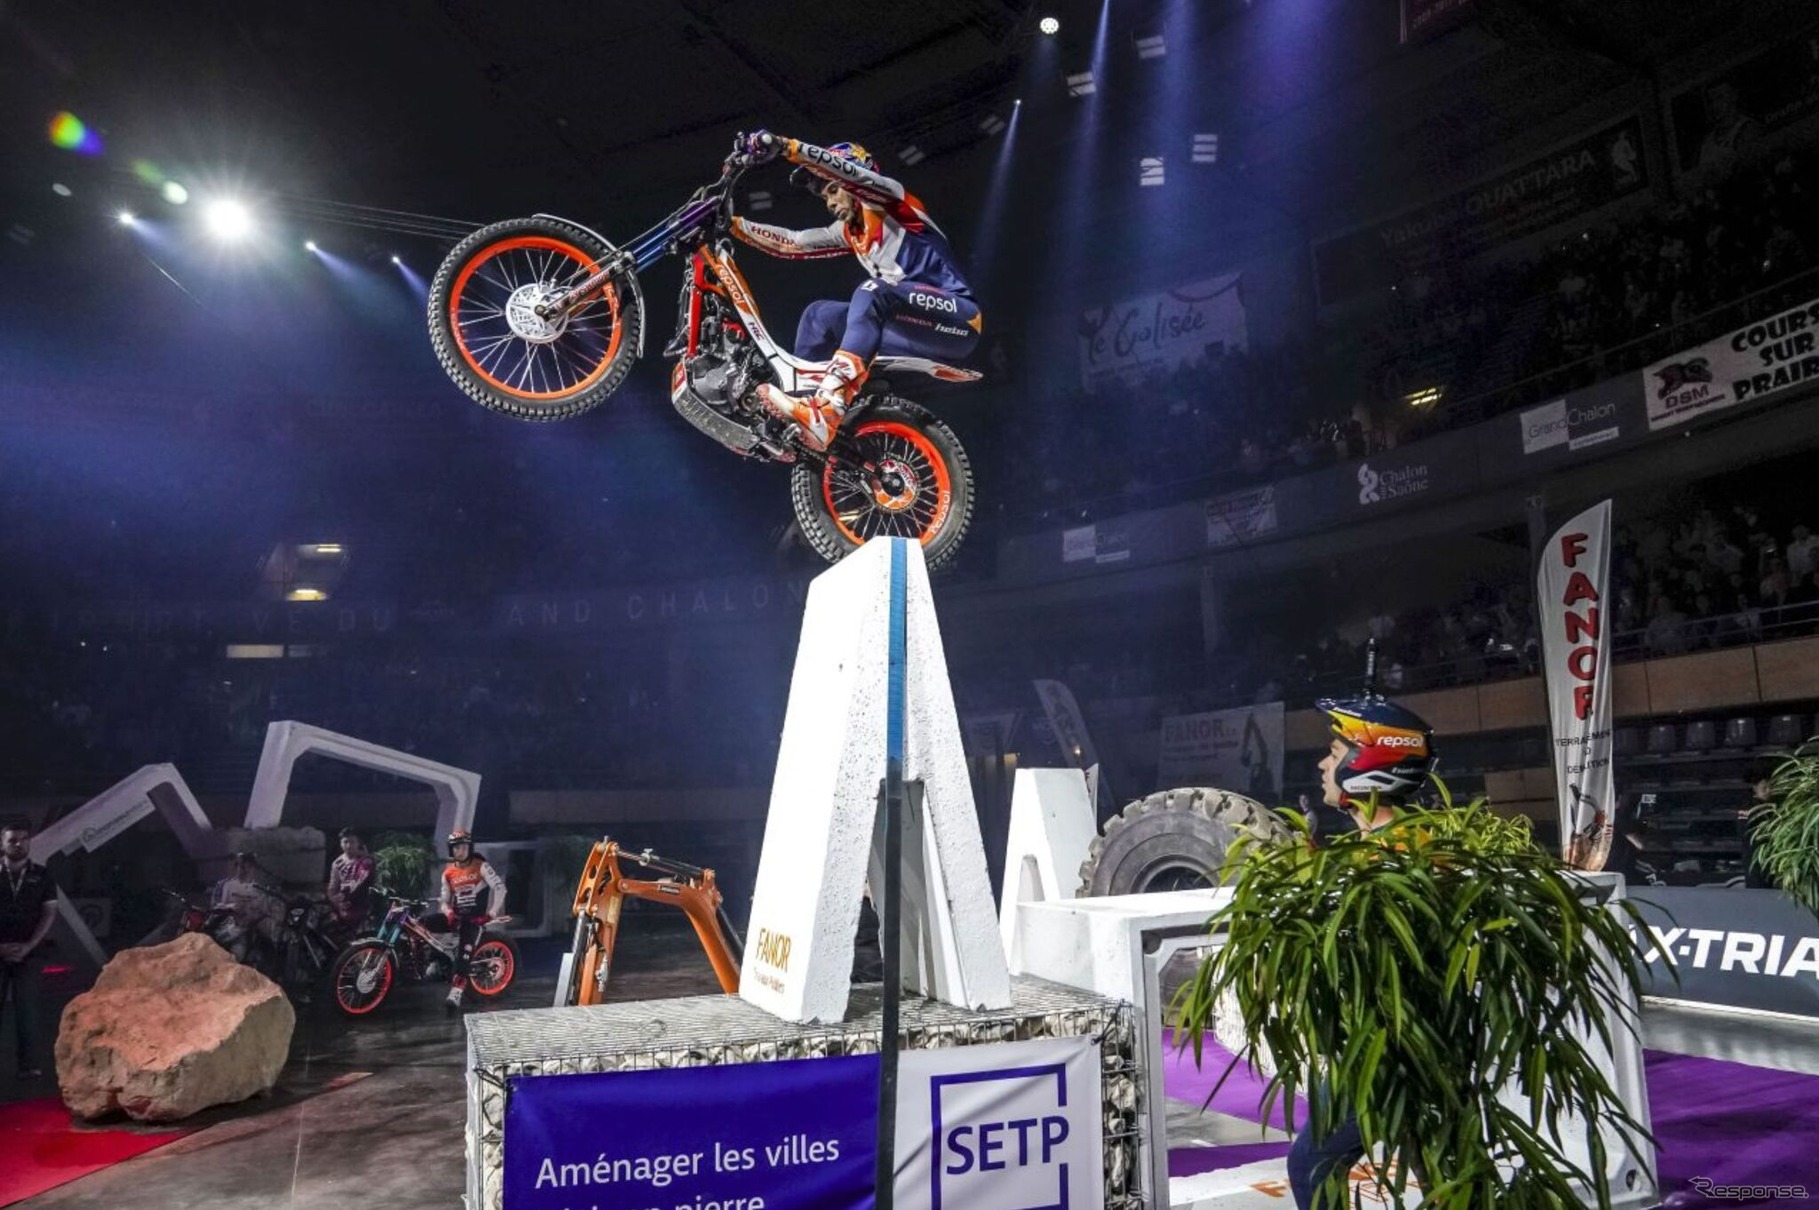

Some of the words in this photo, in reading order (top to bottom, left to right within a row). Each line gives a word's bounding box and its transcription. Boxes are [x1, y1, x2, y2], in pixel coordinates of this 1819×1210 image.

[1466, 150, 1595, 216] OUATTARA
[751, 226, 797, 247] HONDA
[909, 292, 957, 313] repsol
[1759, 333, 1814, 367] SUR
[1666, 384, 1710, 409] DSM
[1380, 465, 1428, 486] Chalon
[1378, 736, 1425, 748] repsol
[756, 928, 792, 973] FANOR
[947, 1116, 1069, 1175] SETP
[535, 1153, 703, 1188] Aménager
[715, 1142, 755, 1172] les
[765, 1134, 839, 1167] villes
